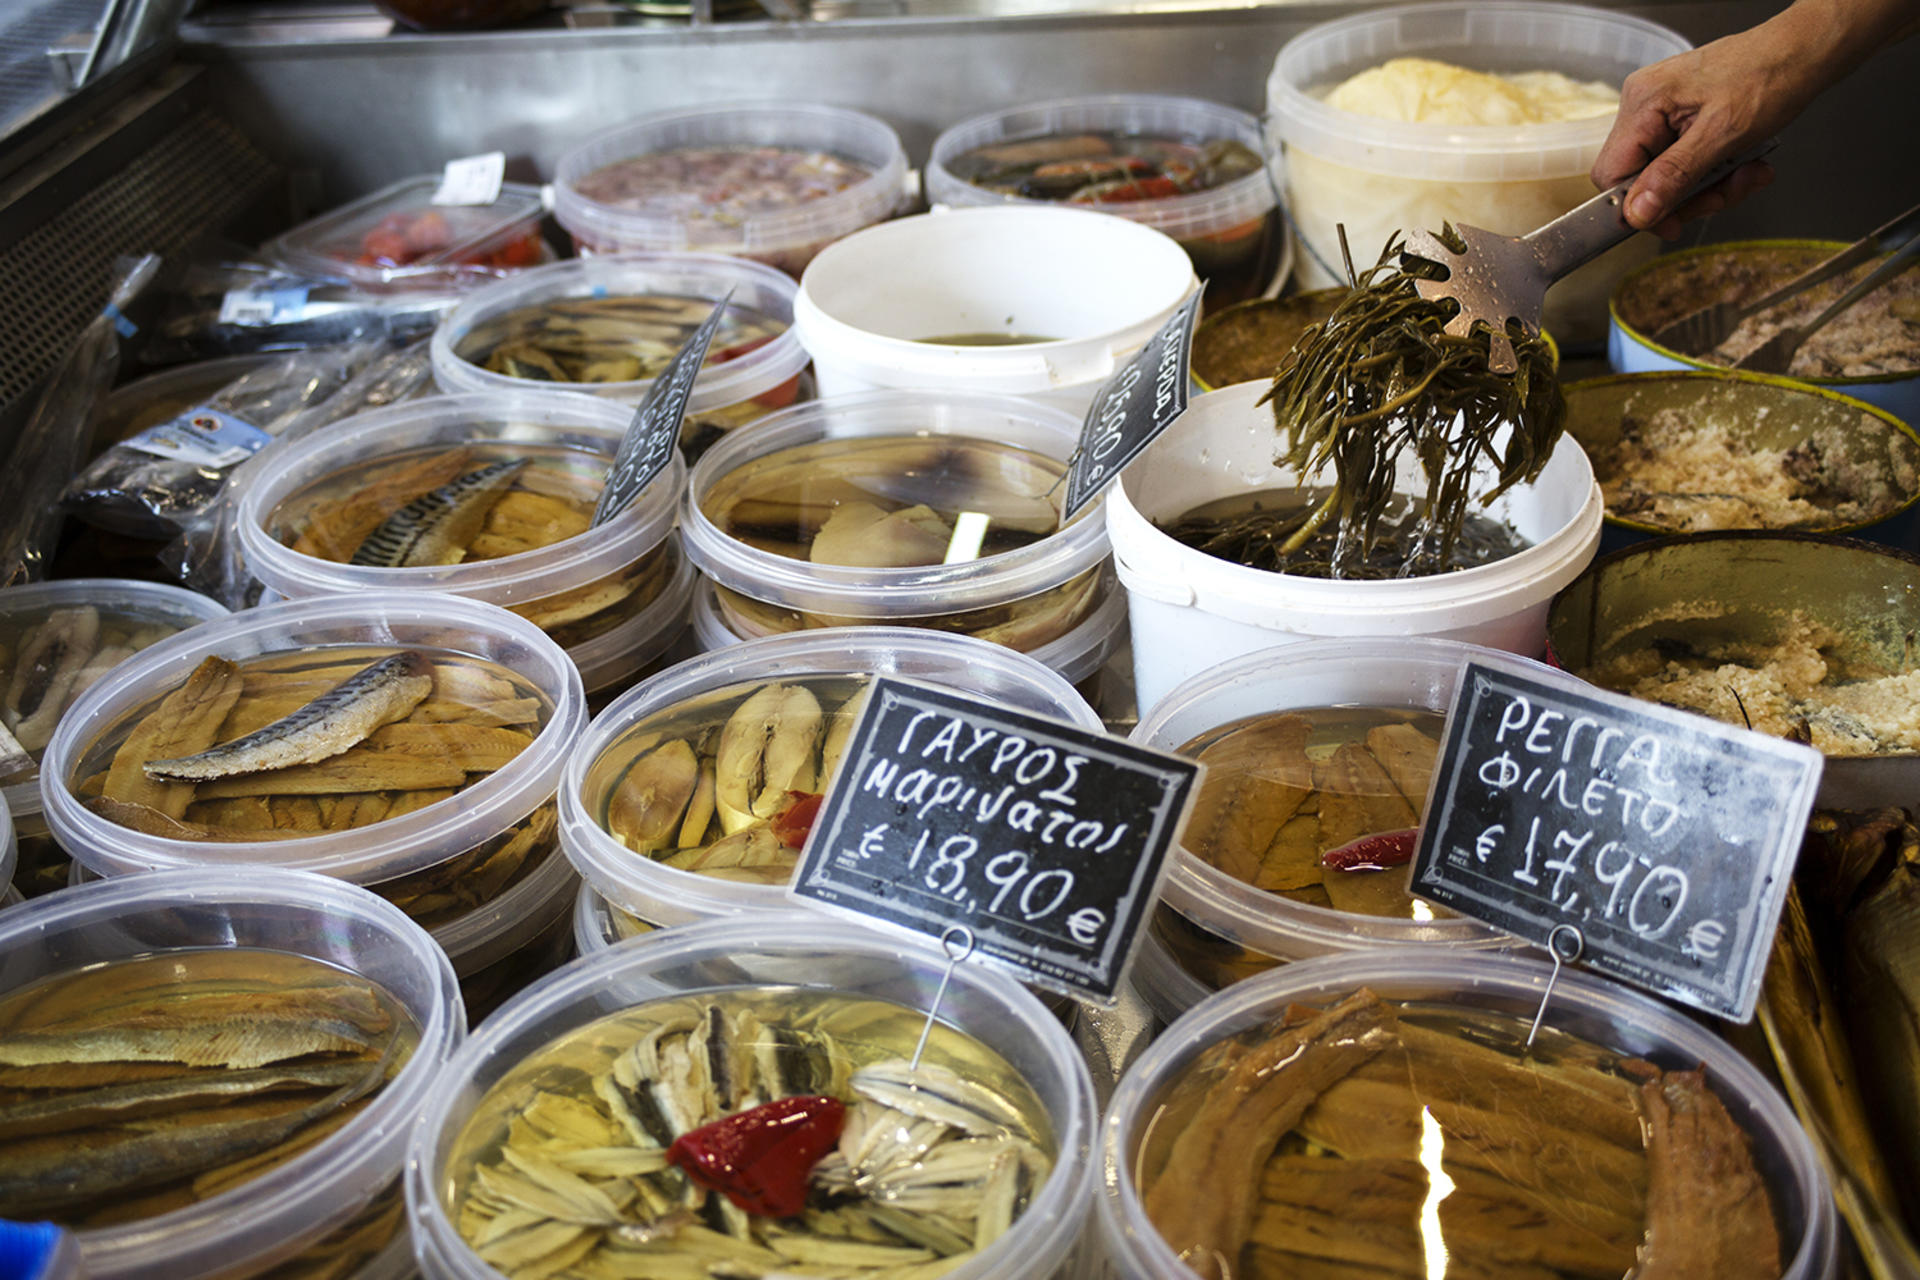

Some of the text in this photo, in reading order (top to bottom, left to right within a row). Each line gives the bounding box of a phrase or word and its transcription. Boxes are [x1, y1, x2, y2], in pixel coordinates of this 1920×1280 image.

[897, 710, 1090, 805] ΓΑΥΡΟΣ
[1496, 695, 1677, 788] ΡΕΓΓΑ
[1479, 752, 1679, 838] ΦΙΛΕΤΟ
[1065, 907, 1106, 945] €
